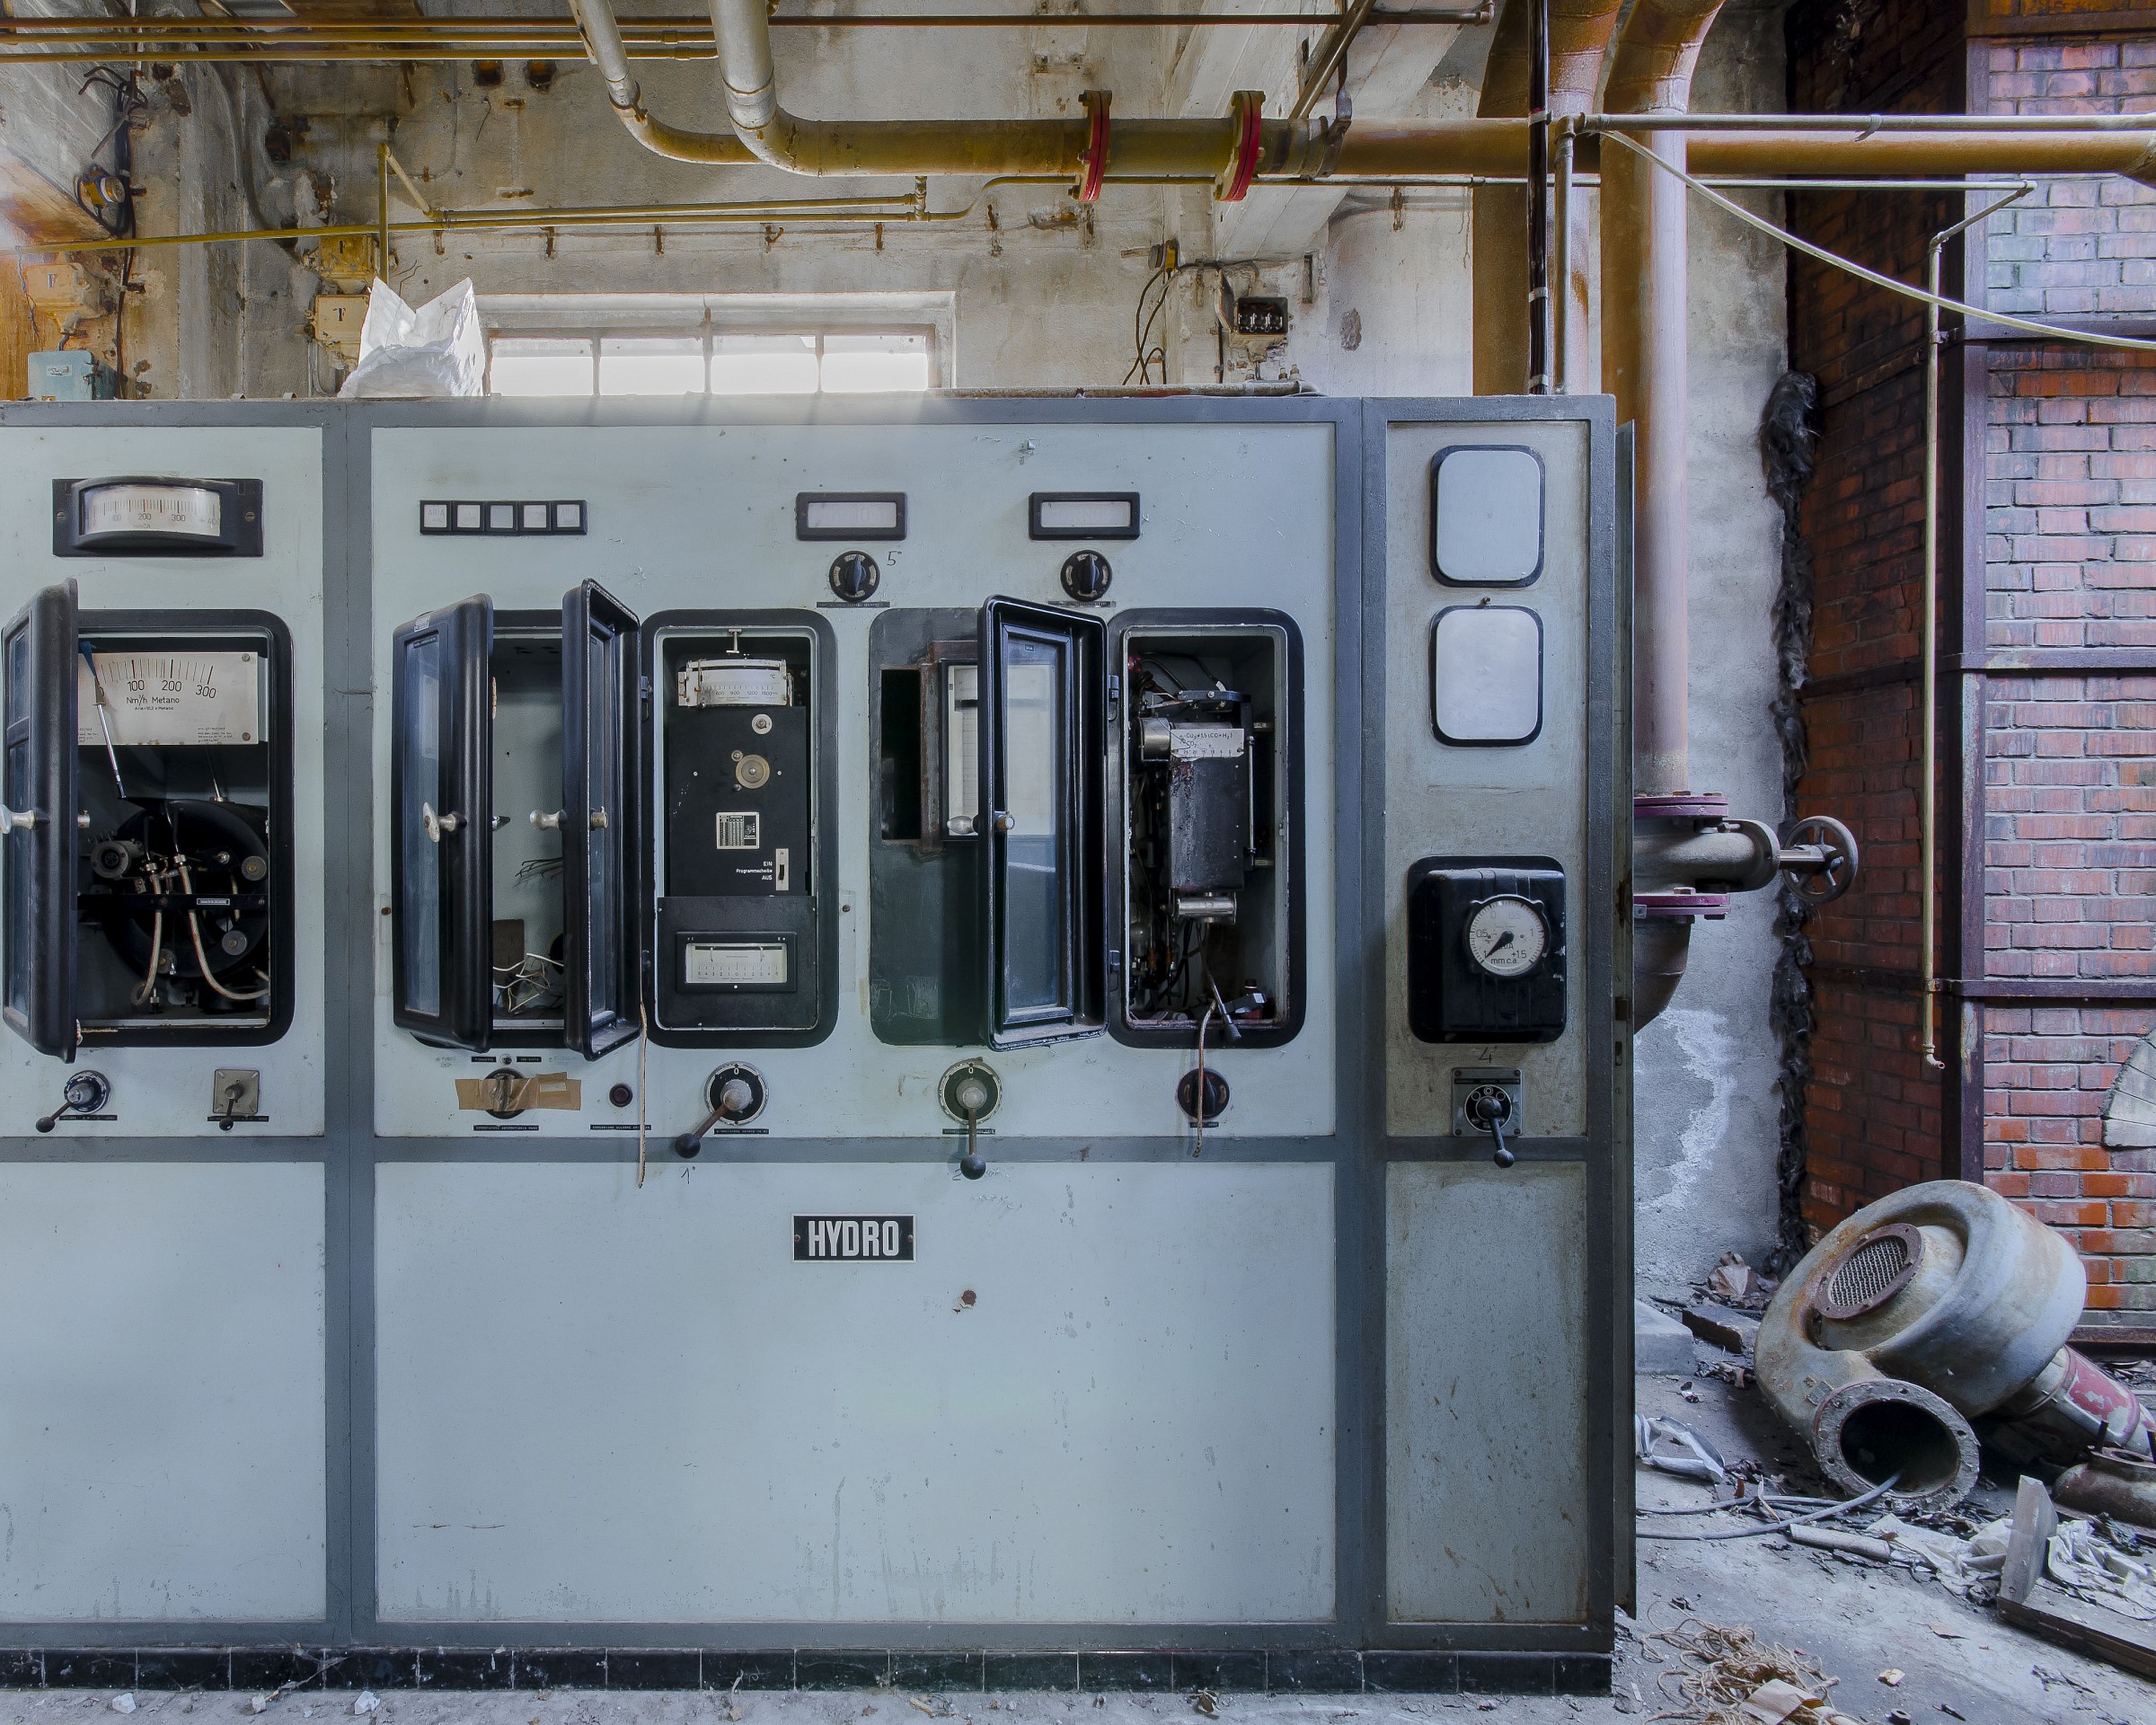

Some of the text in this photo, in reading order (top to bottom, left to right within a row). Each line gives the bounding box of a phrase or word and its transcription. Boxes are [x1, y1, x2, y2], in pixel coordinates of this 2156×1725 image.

[137, 513, 152, 521] 200
[171, 514, 186, 522] 300
[127, 679, 216, 699] 100 200 300
[151, 695, 180, 704] Metano
[1530, 928, 1534, 936] 1
[733, 1067, 739, 1075] 0
[968, 1066, 974, 1075] 0
[808, 1220, 898, 1256] HYDRO
